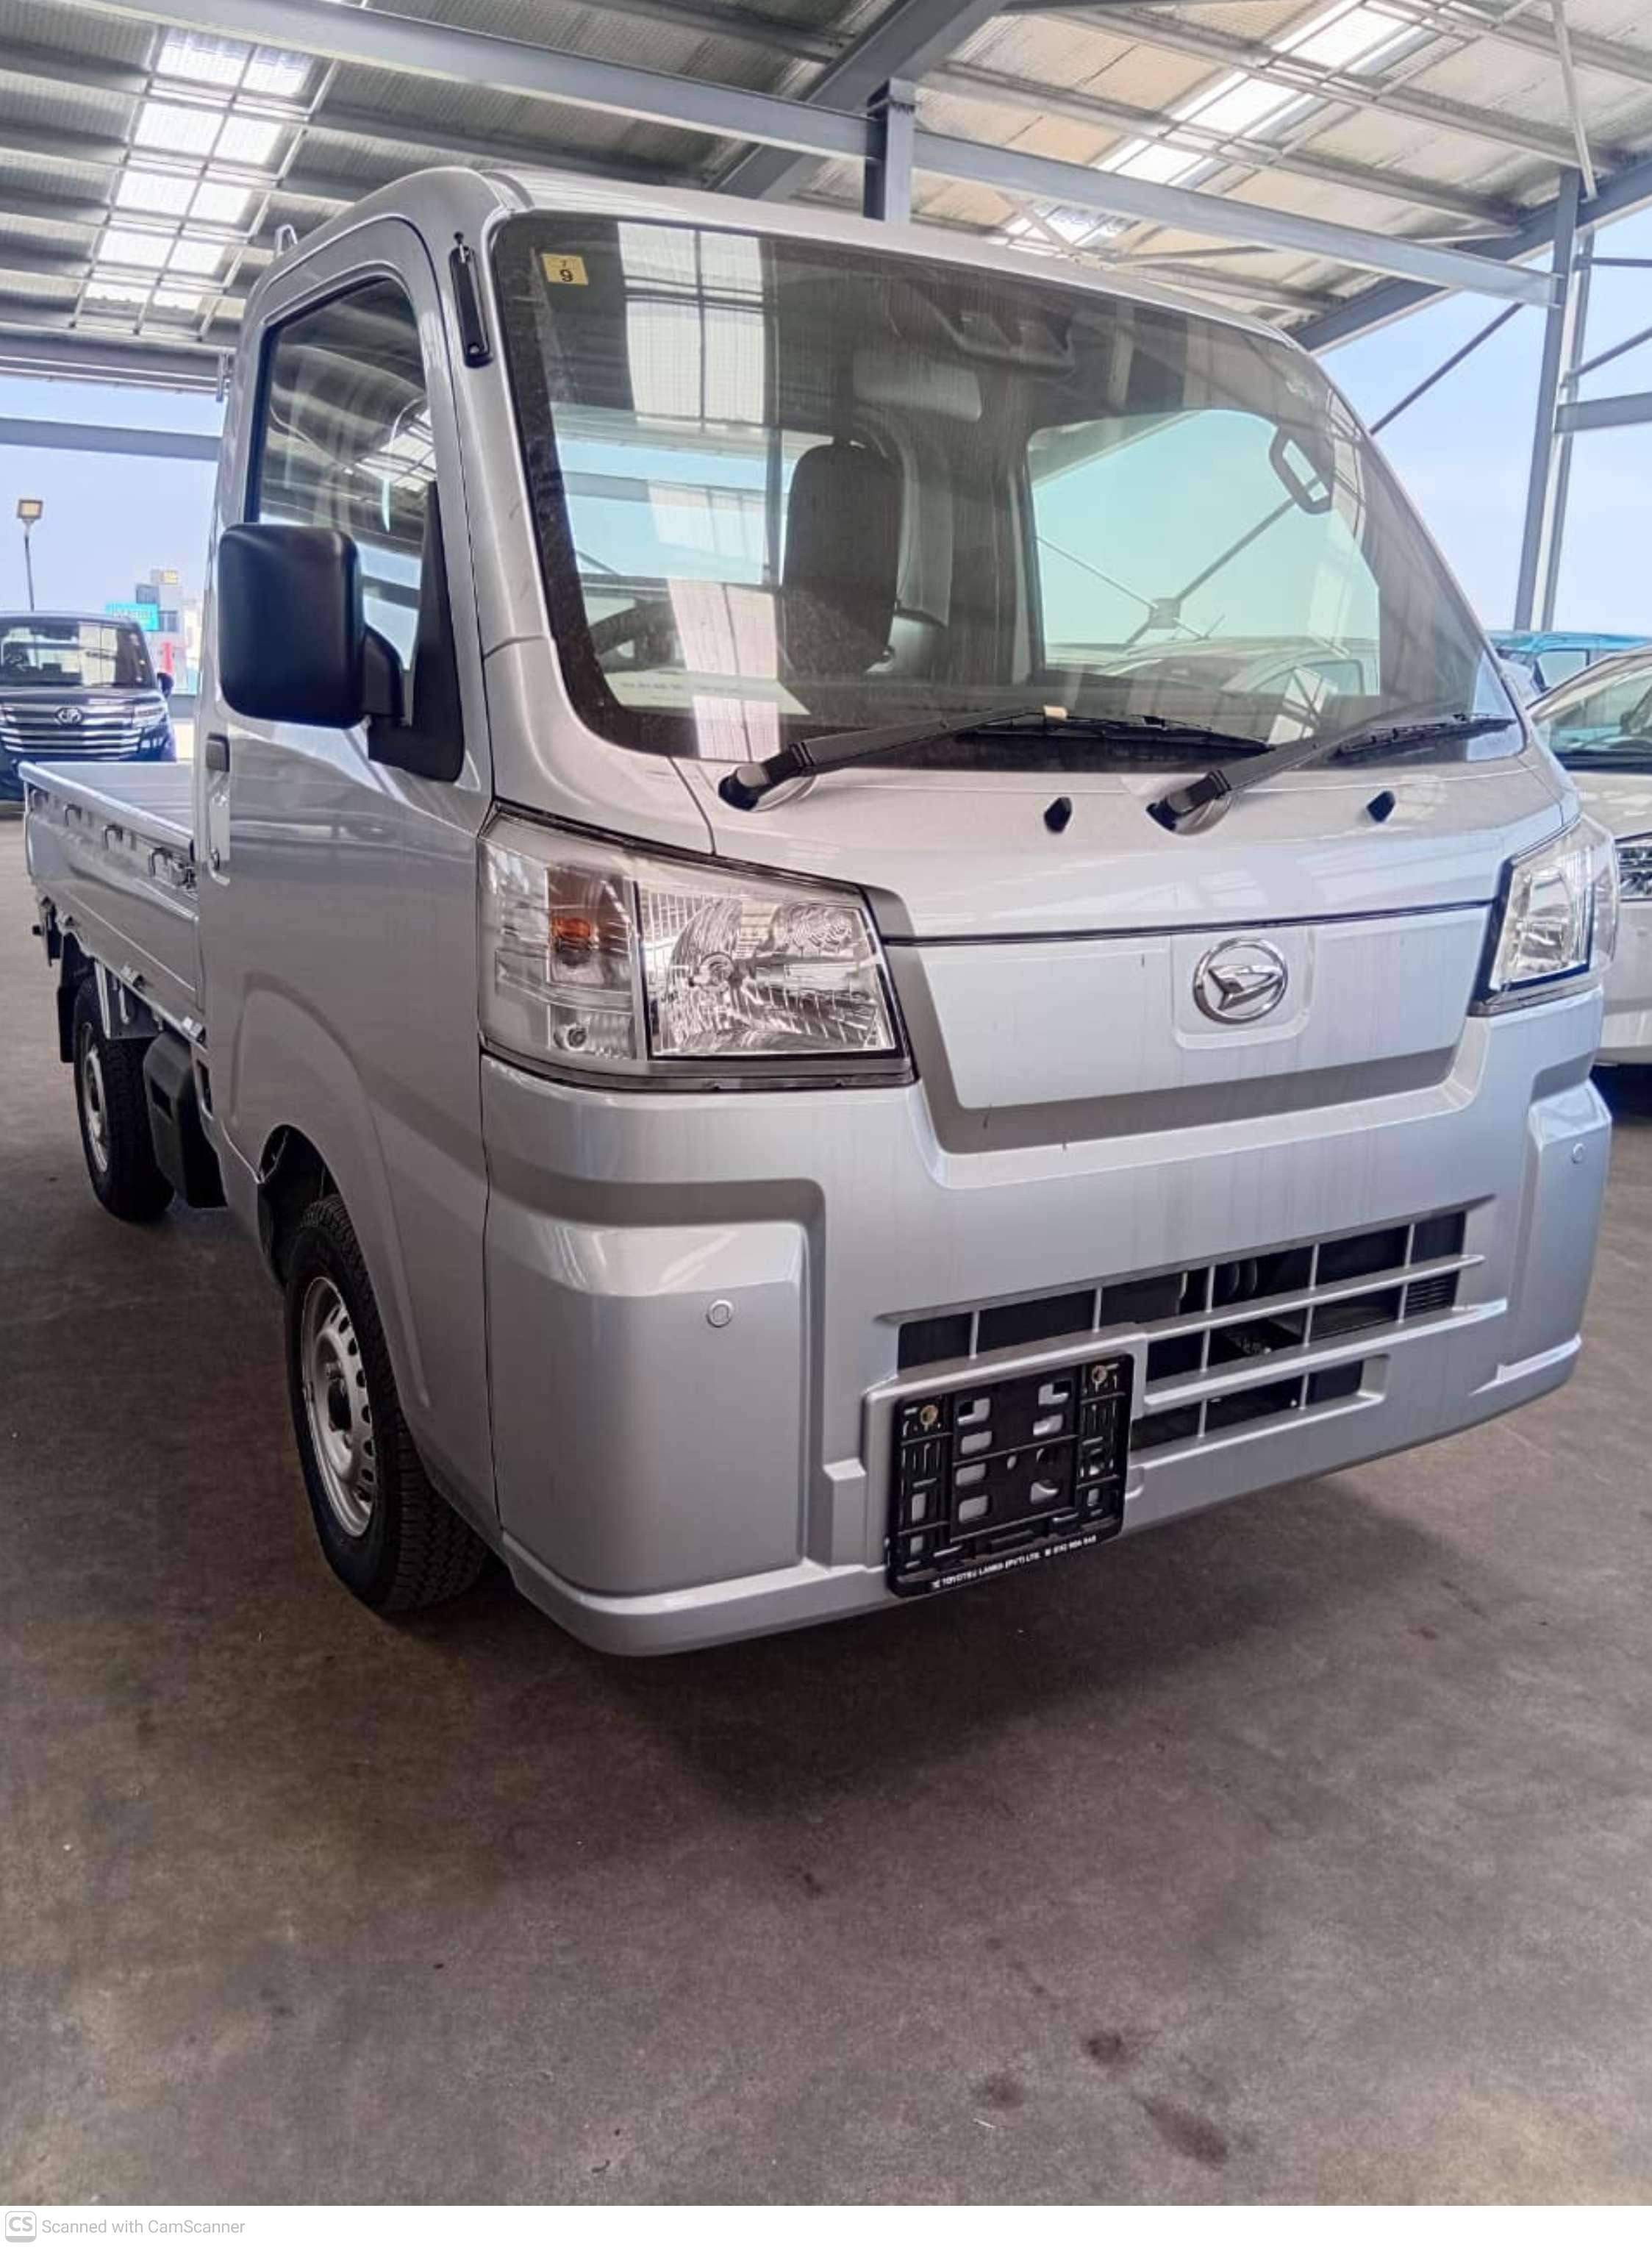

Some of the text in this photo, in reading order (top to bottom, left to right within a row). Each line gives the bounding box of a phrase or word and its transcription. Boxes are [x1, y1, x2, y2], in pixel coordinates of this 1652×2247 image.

[942, 1569, 977, 1586] TOYOTSU
[979, 1562, 1004, 1576] LANKA
[1004, 1555, 1025, 1569] (PVT)
